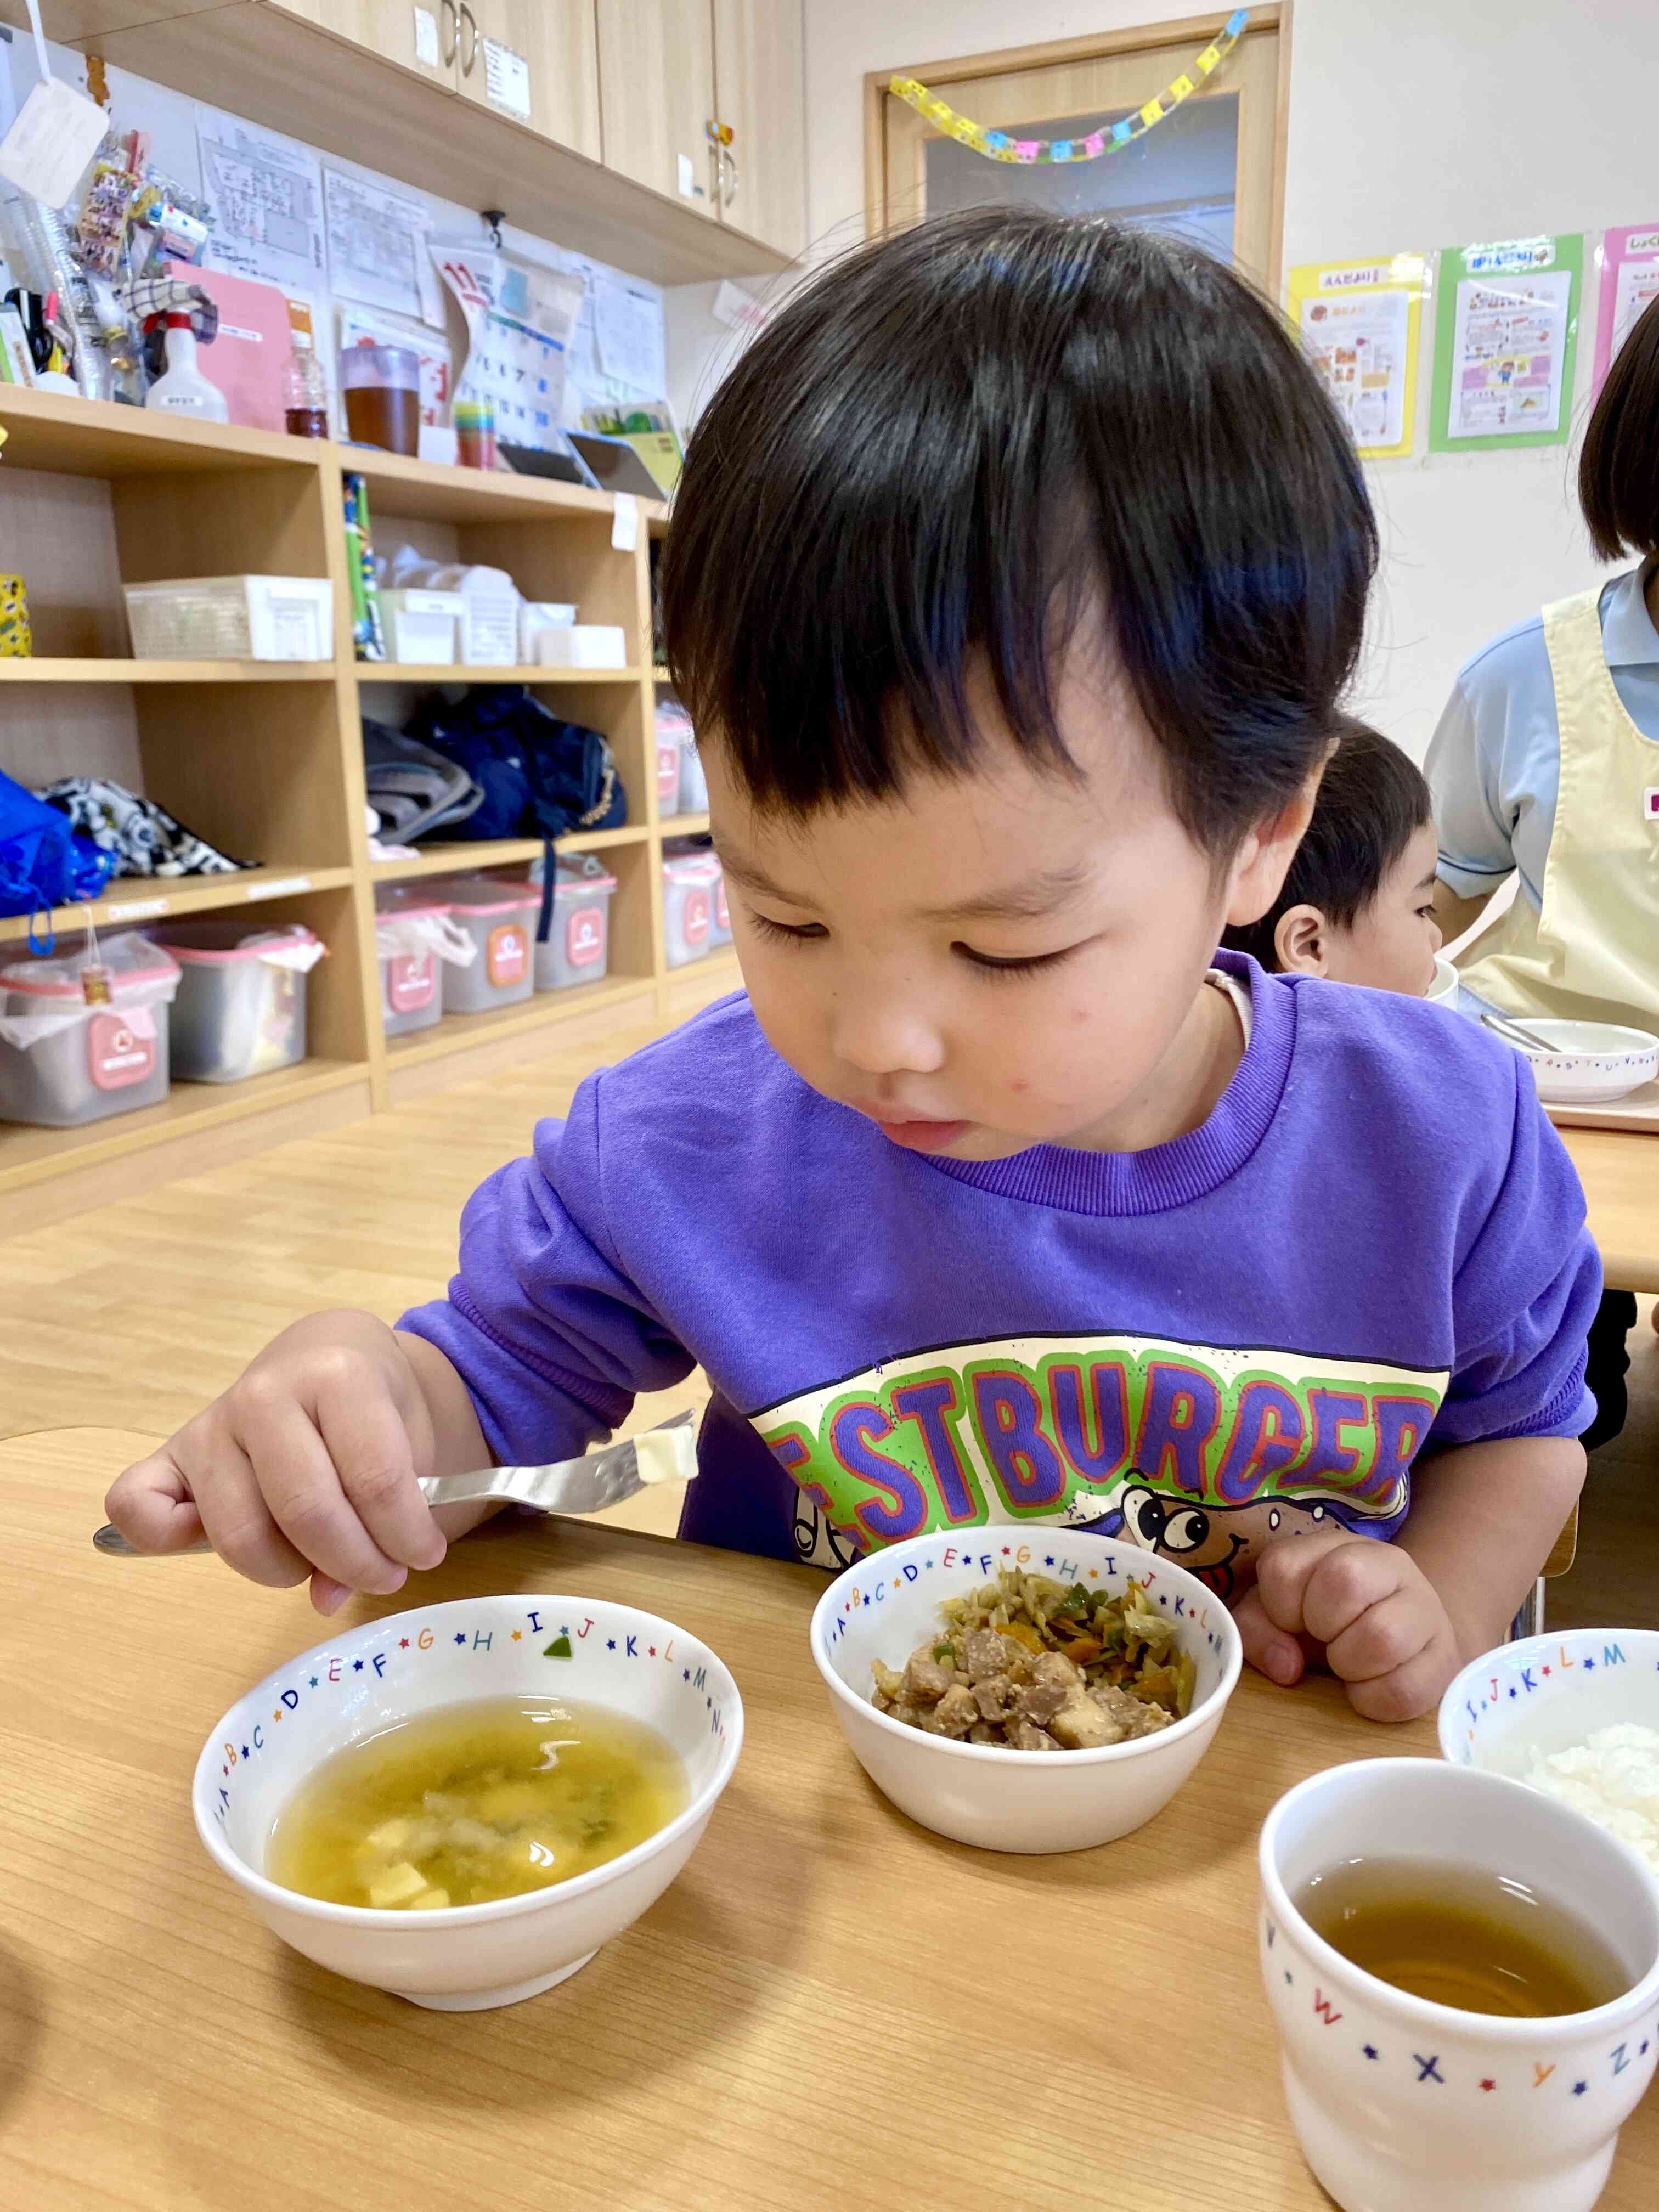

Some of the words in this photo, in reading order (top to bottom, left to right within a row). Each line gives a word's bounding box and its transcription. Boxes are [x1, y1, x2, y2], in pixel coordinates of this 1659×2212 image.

[837, 1618, 846, 1636] A
[852, 1587, 861, 1607] B
[876, 1582, 884, 1601] C
[903, 1565, 918, 1582] D
[943, 1548, 958, 1568] E
[980, 1554, 992, 1575] F
[1017, 1545, 1031, 1563] G
[1059, 1559, 1078, 1579] H
[1105, 1556, 1116, 1575] I
[1141, 1571, 1156, 1589] J
[1175, 1595, 1184, 1616] K
[224, 1743, 237, 1765] B
[253, 1724, 264, 1748] C
[281, 1690, 298, 1709] D
[329, 1658, 343, 1681] E
[373, 1653, 387, 1678] F
[418, 1628, 434, 1650] G
[473, 1630, 493, 1651] H
[527, 1611, 543, 1633] I
[577, 1618, 594, 1639] J
[627, 1635, 638, 1657] K
[664, 1640, 673, 1662] L
[693, 1666, 707, 1692] M
[1490, 1678, 1498, 1701] J
[1521, 1668, 1538, 1692] K
[1560, 1646, 1574, 1668] L
[1604, 1644, 1626, 1667] M
[1315, 1987, 1343, 2025] W
[1413, 2053, 1445, 2084] X
[1532, 2063, 1556, 2089] Y
[1610, 2043, 1630, 2075] Z
